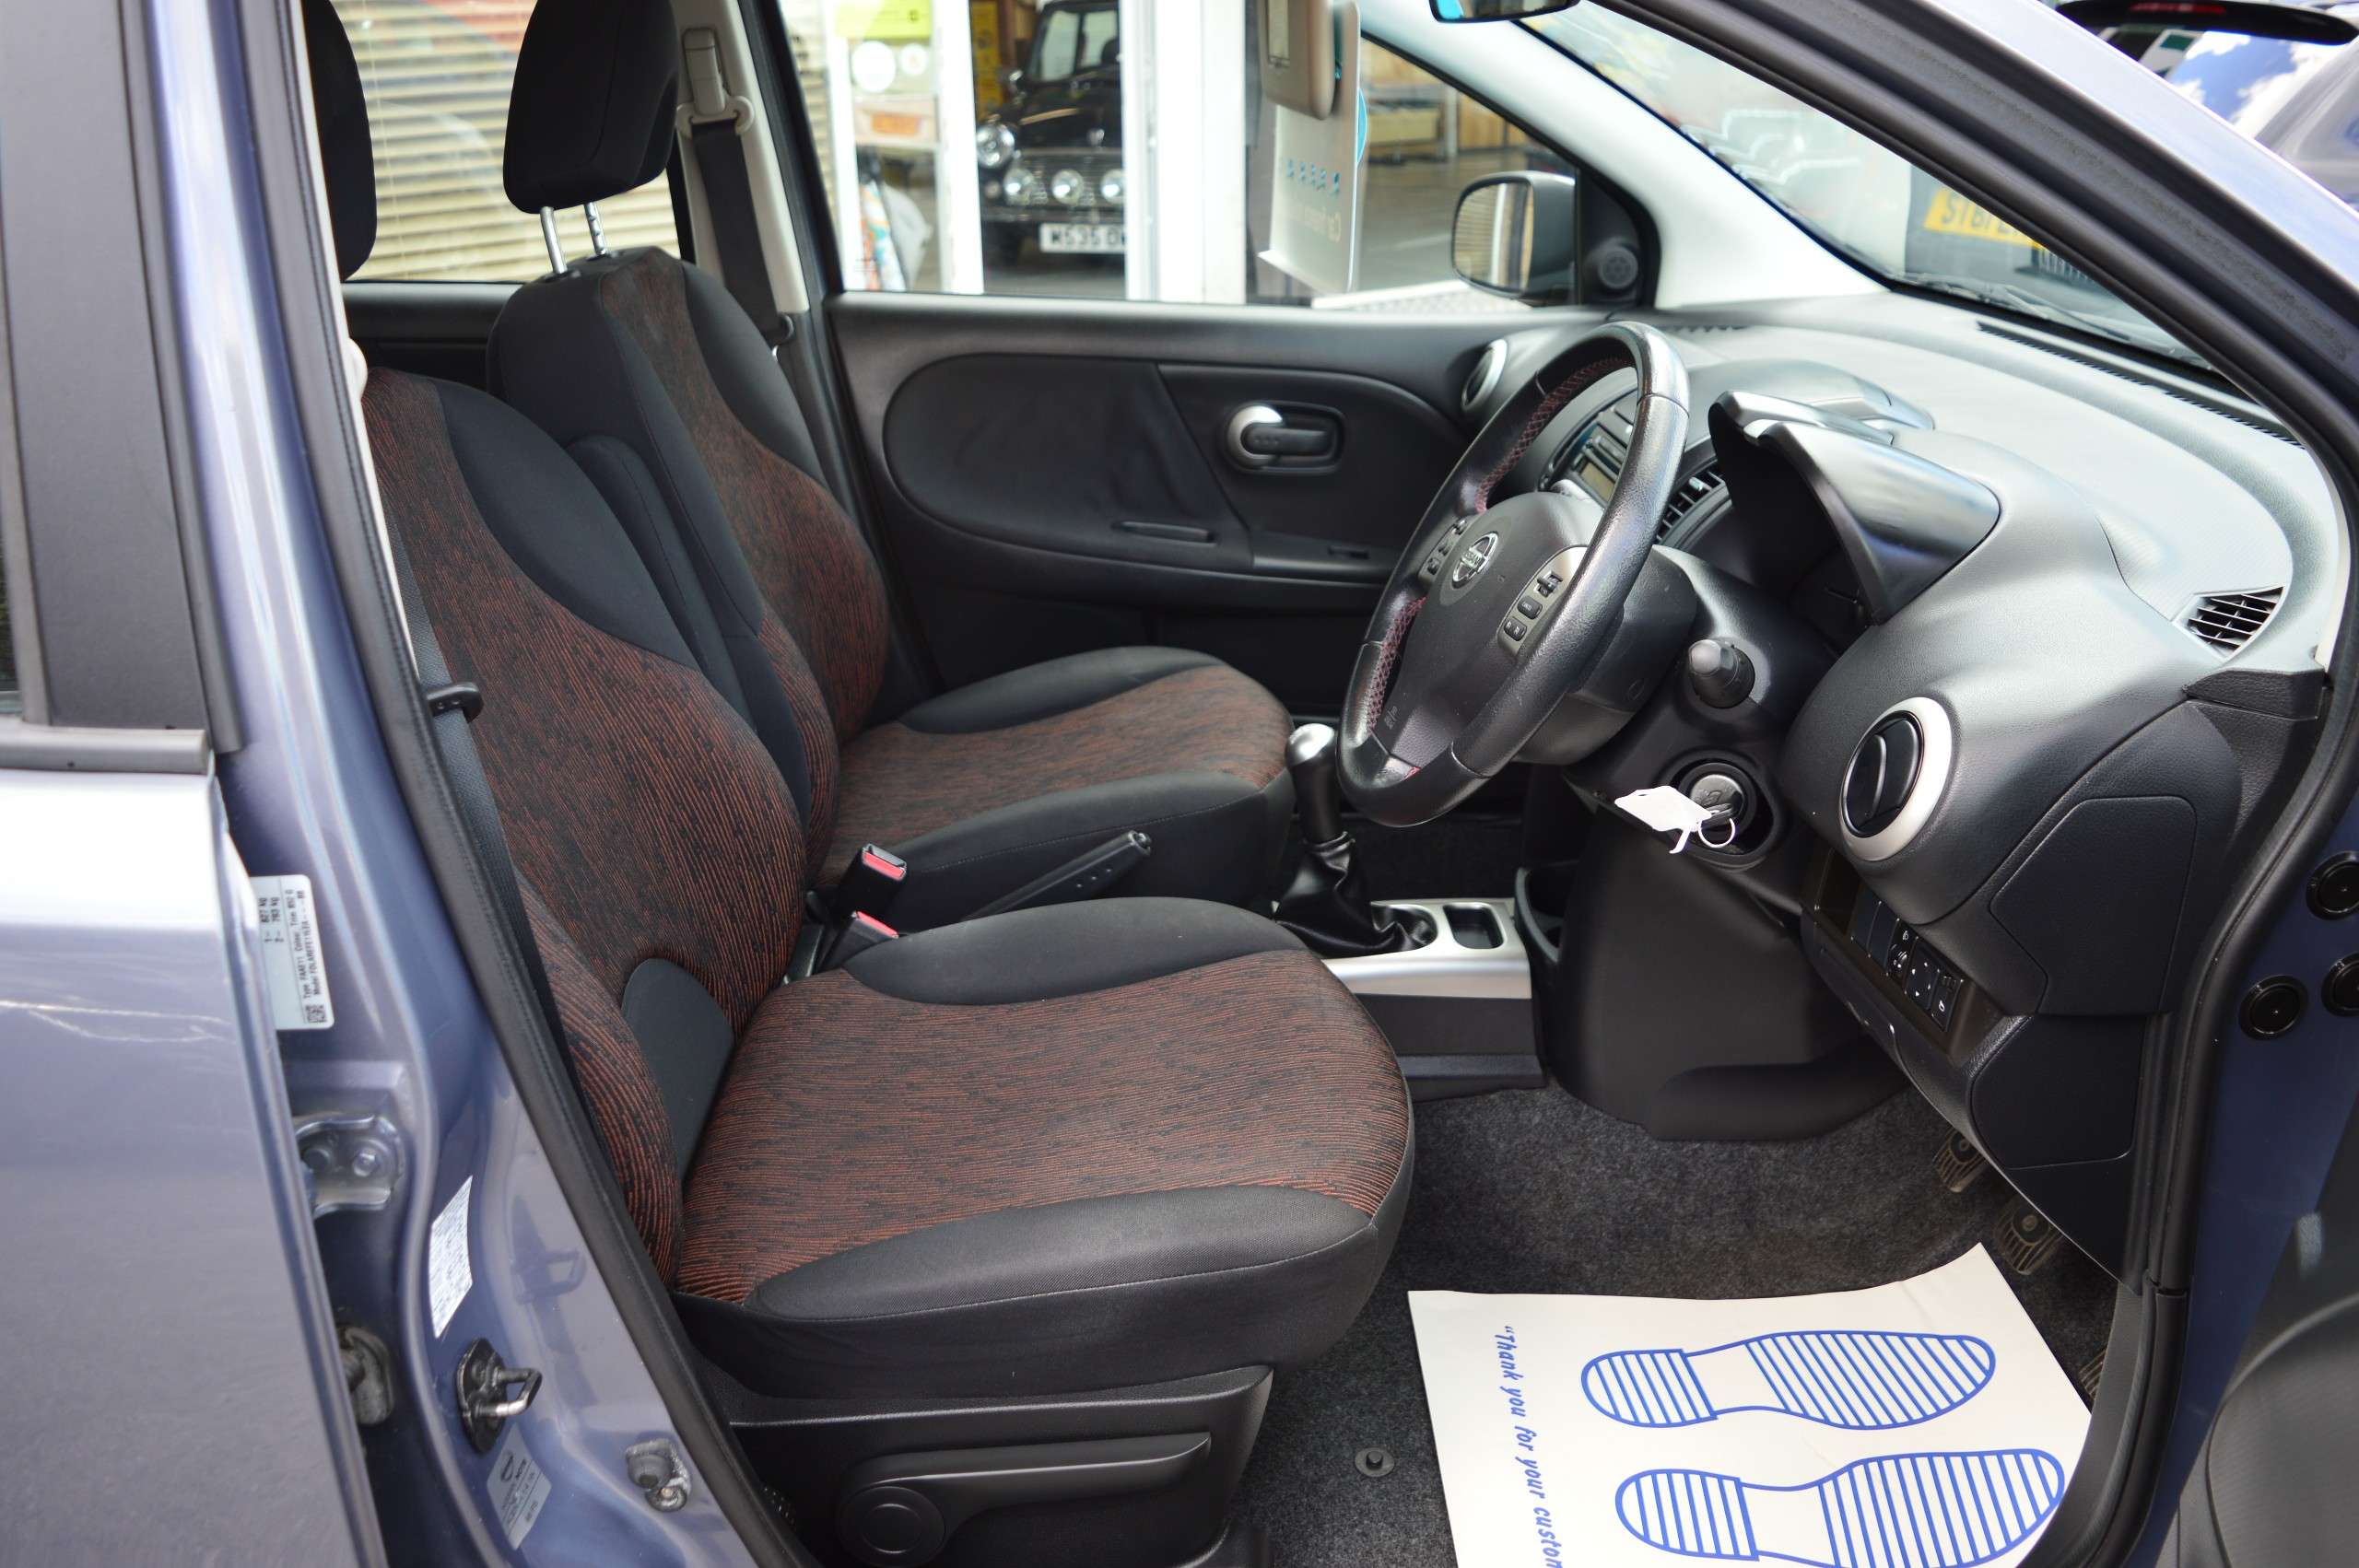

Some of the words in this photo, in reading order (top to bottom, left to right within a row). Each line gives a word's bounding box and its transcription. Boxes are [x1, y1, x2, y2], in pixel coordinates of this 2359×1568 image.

[1499, 1385, 1526, 1418] you
[1514, 1424, 1538, 1453] for
[1514, 1456, 1546, 1500] your
